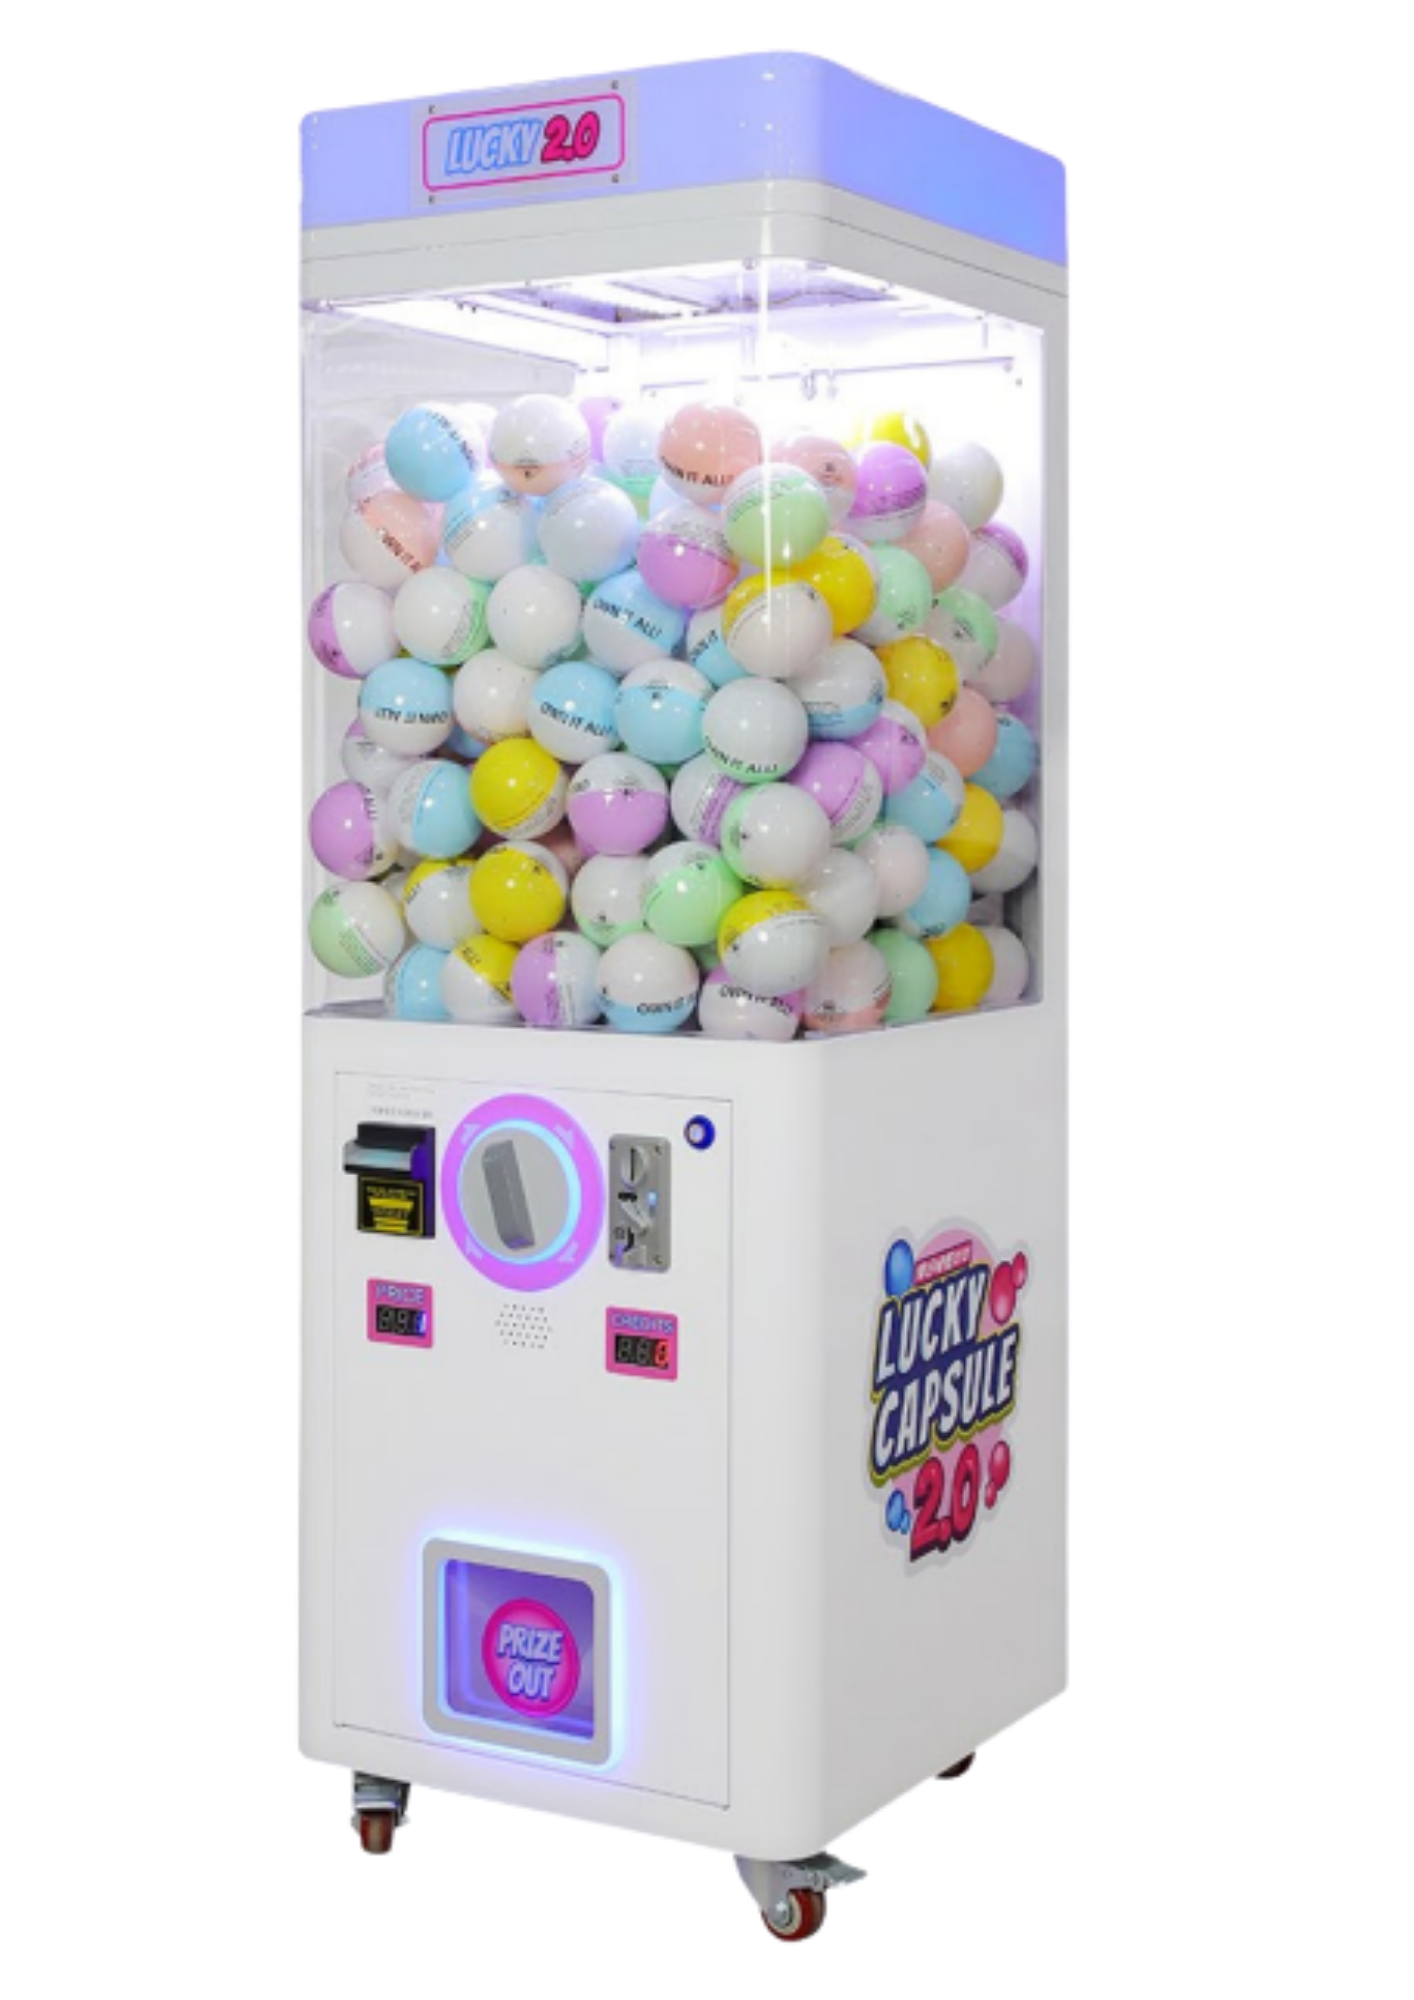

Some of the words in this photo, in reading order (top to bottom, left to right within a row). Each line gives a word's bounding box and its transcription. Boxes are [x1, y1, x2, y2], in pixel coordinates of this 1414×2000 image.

[445, 118, 543, 175] LUCKY
[541, 112, 600, 164] 2.0
[685, 471, 699, 483] IT
[593, 599, 621, 618] OWN
[540, 701, 569, 724] OWN
[568, 716, 584, 731] IT
[376, 1284, 424, 1304] PRICE
[611, 1313, 675, 1335] CREDITS
[877, 1269, 987, 1384] LUCKY
[873, 1331, 1017, 1469] CAPSULE
[910, 1443, 980, 1561] 2.0
[496, 1622, 564, 1666] PRIZE
[506, 1661, 557, 1701] OUT
